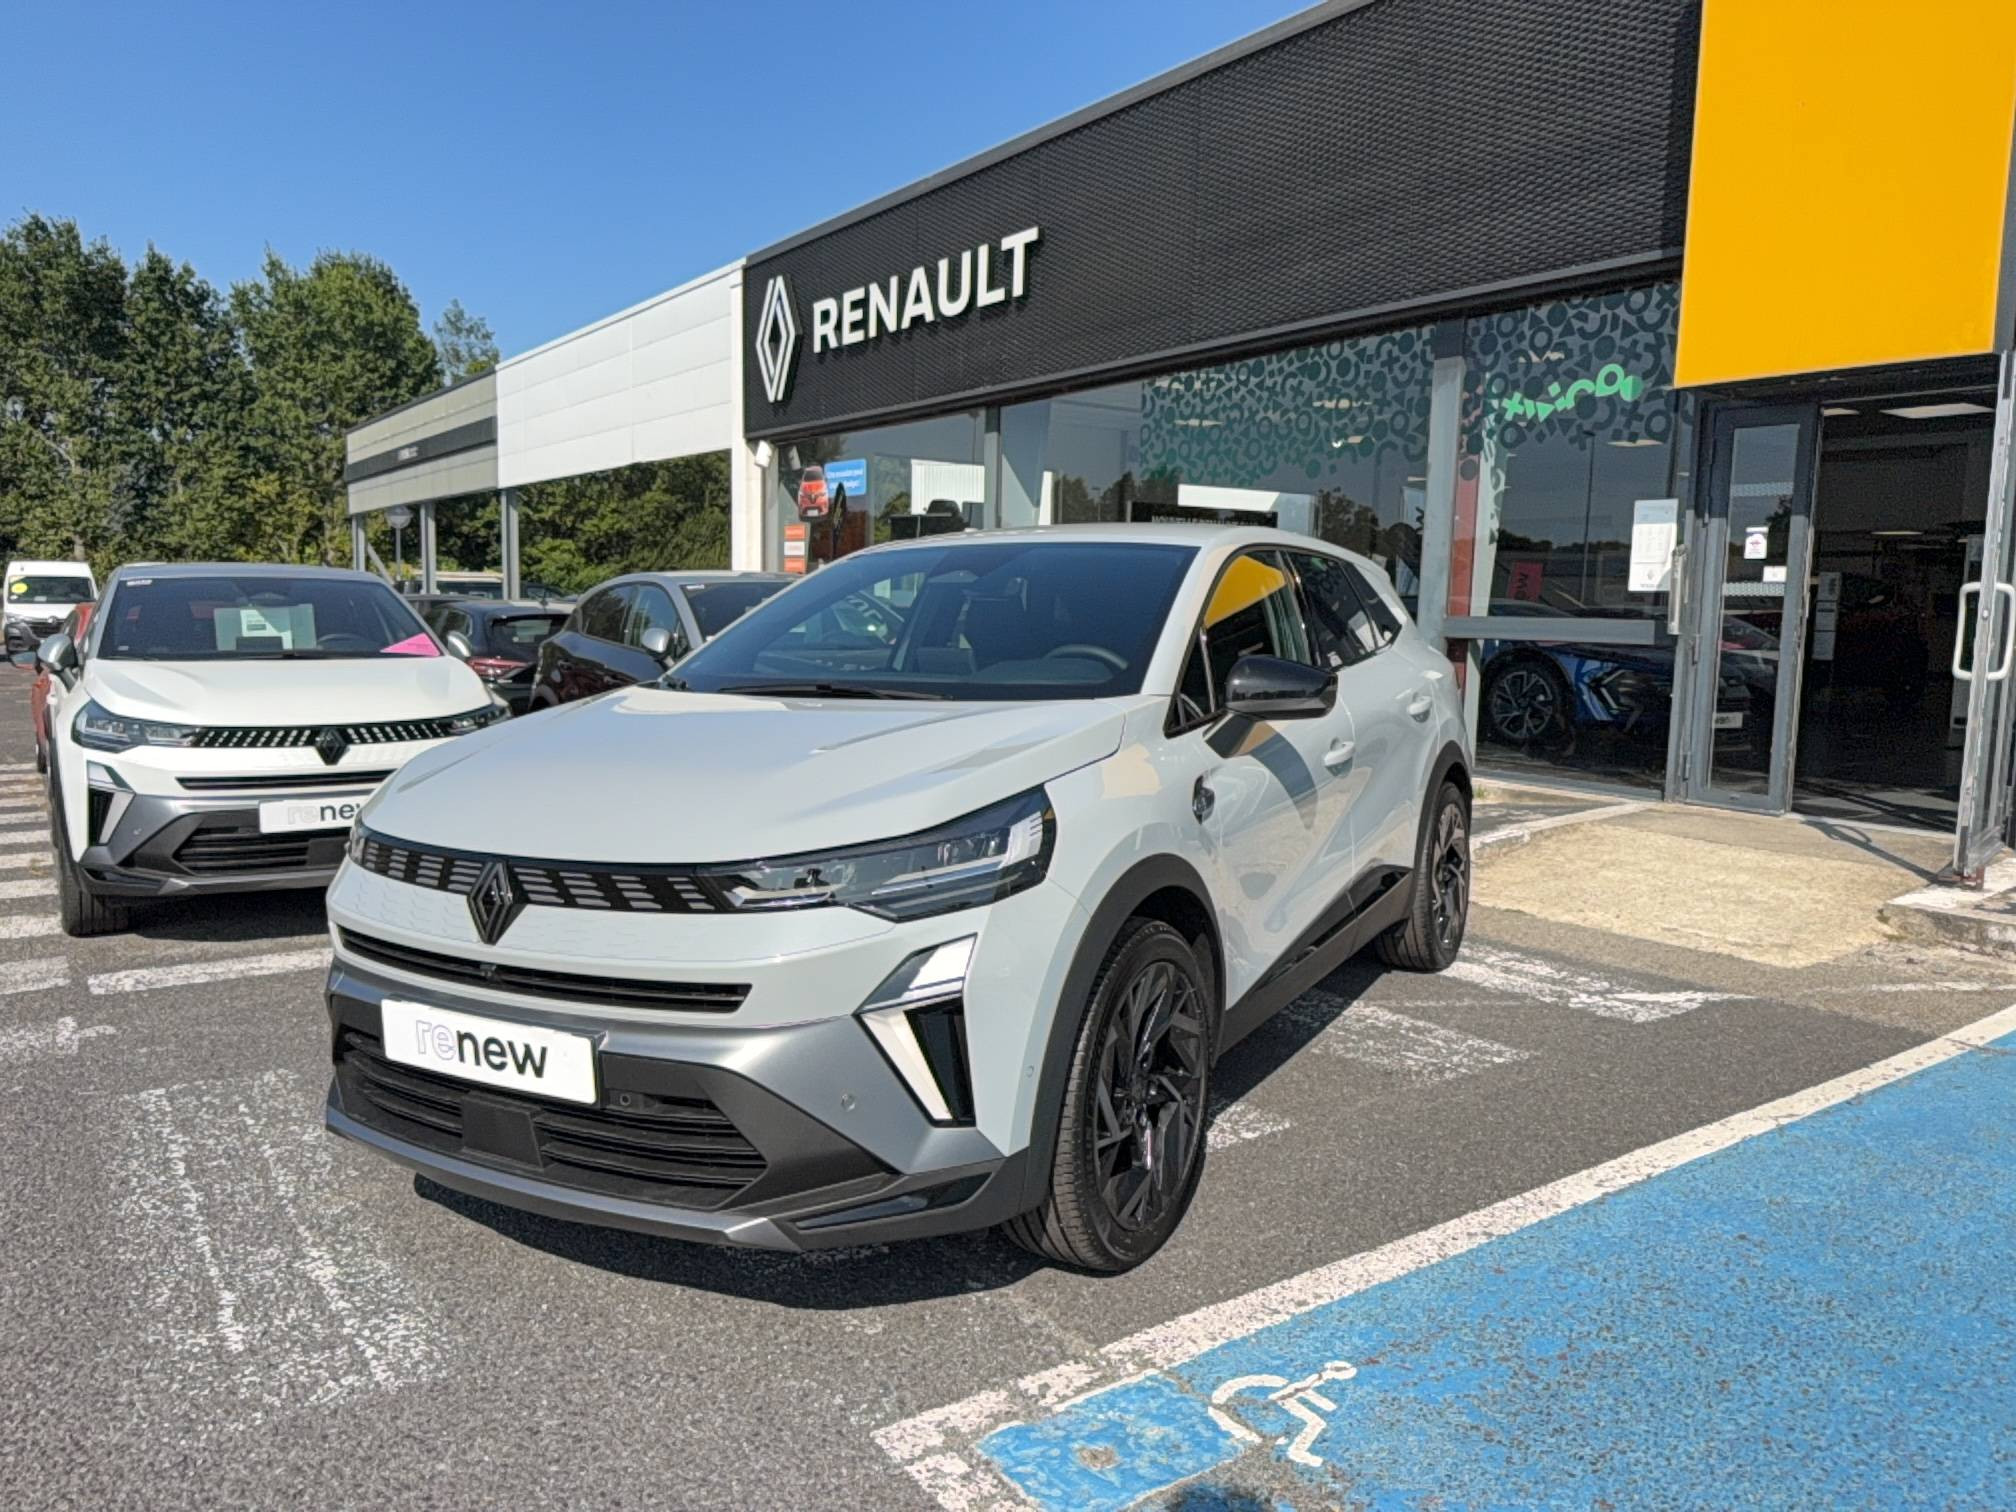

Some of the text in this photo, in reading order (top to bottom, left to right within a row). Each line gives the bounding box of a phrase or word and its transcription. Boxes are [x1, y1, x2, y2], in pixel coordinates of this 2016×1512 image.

[813, 226, 1039, 353] RENAULT
[287, 803, 360, 825] rene
[415, 1020, 547, 1078] renew
